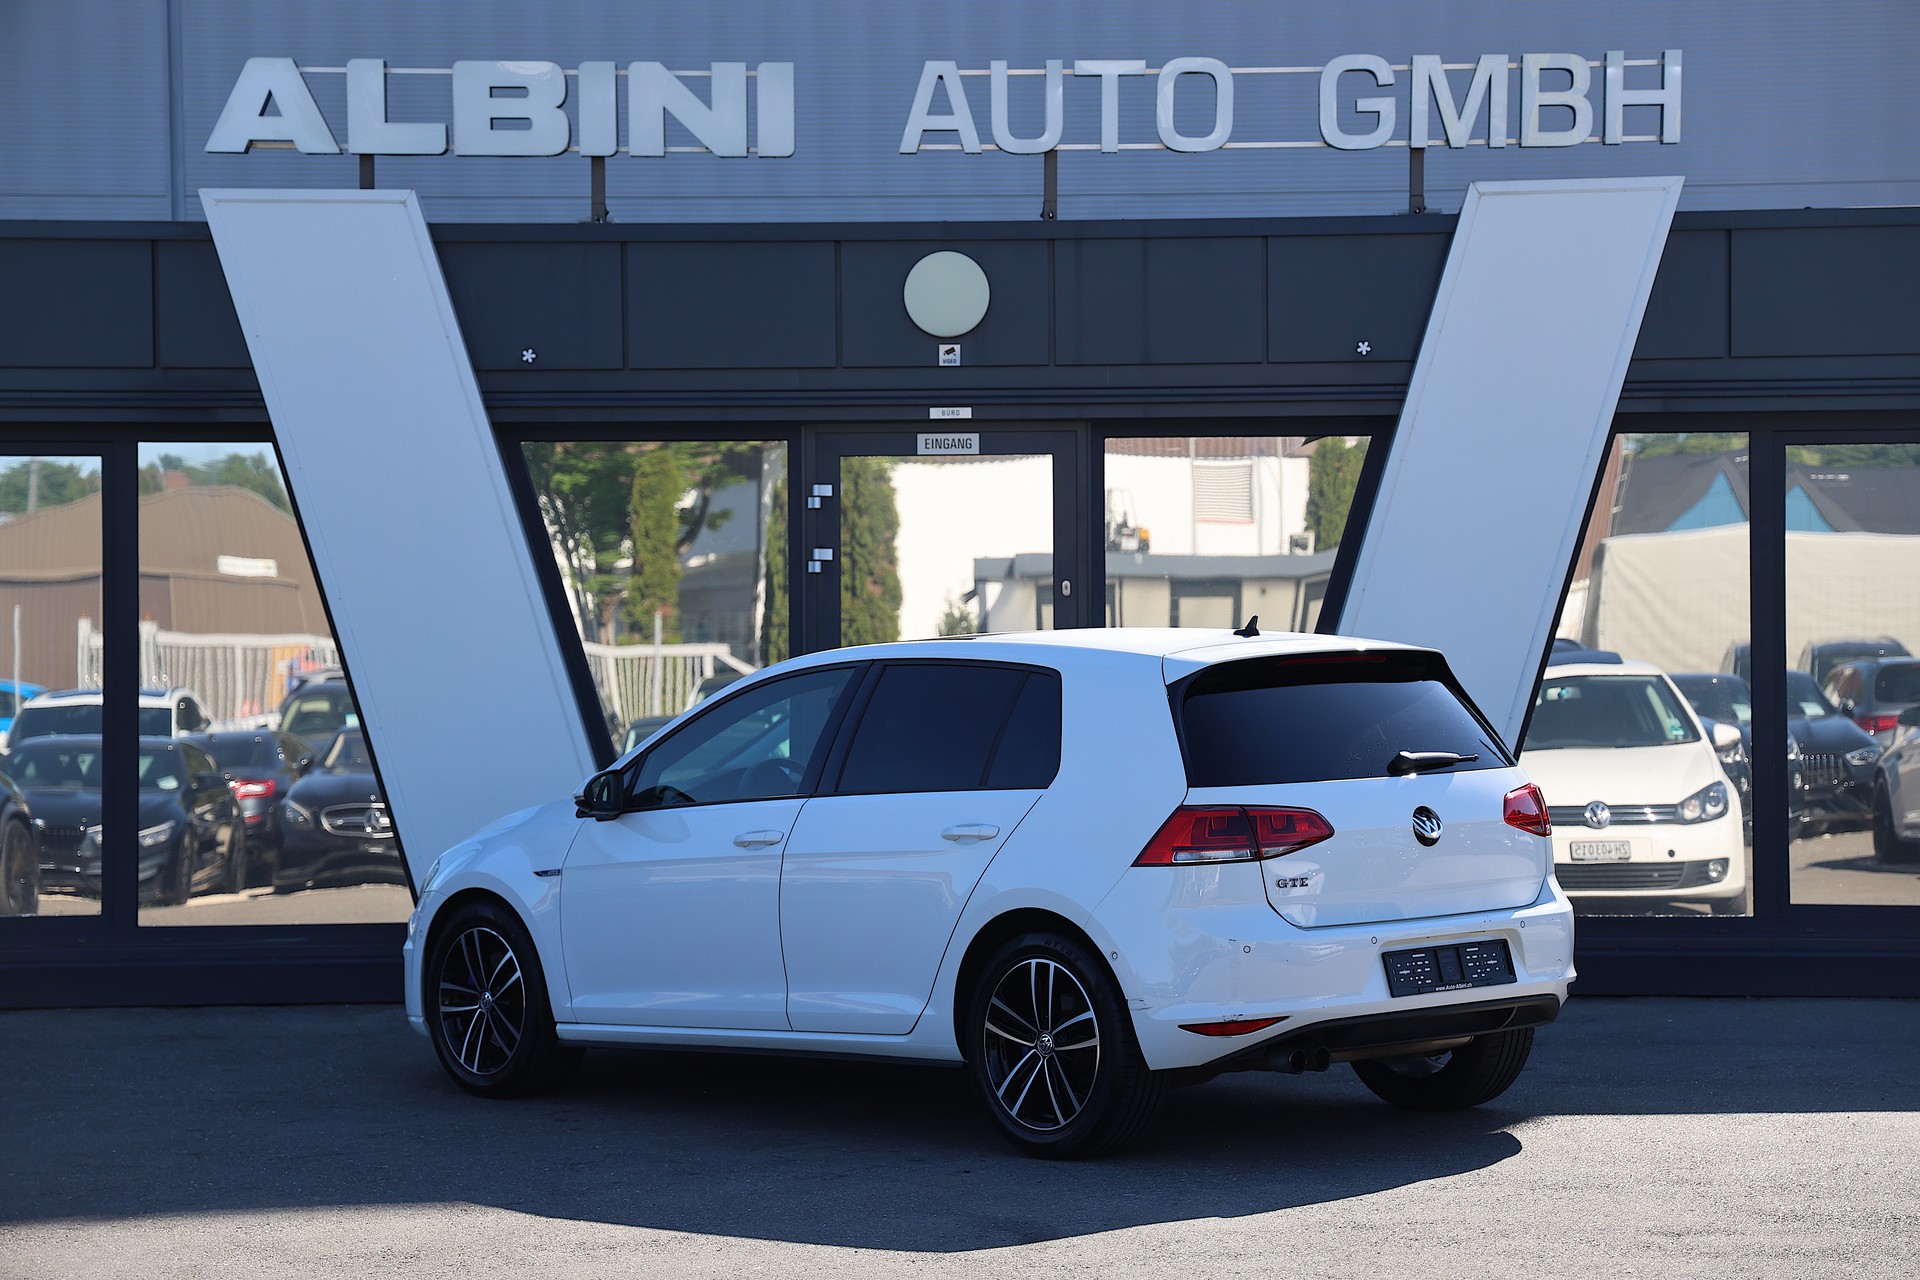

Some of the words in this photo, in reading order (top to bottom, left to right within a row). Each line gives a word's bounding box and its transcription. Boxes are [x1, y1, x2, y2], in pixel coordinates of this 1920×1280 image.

[204, 57, 796, 158] ALBINI
[898, 56, 1235, 155] AUTO
[1318, 48, 1683, 151] GMBH
[924, 437, 973, 450] EINGANG
[1275, 876, 1309, 889] GTE
